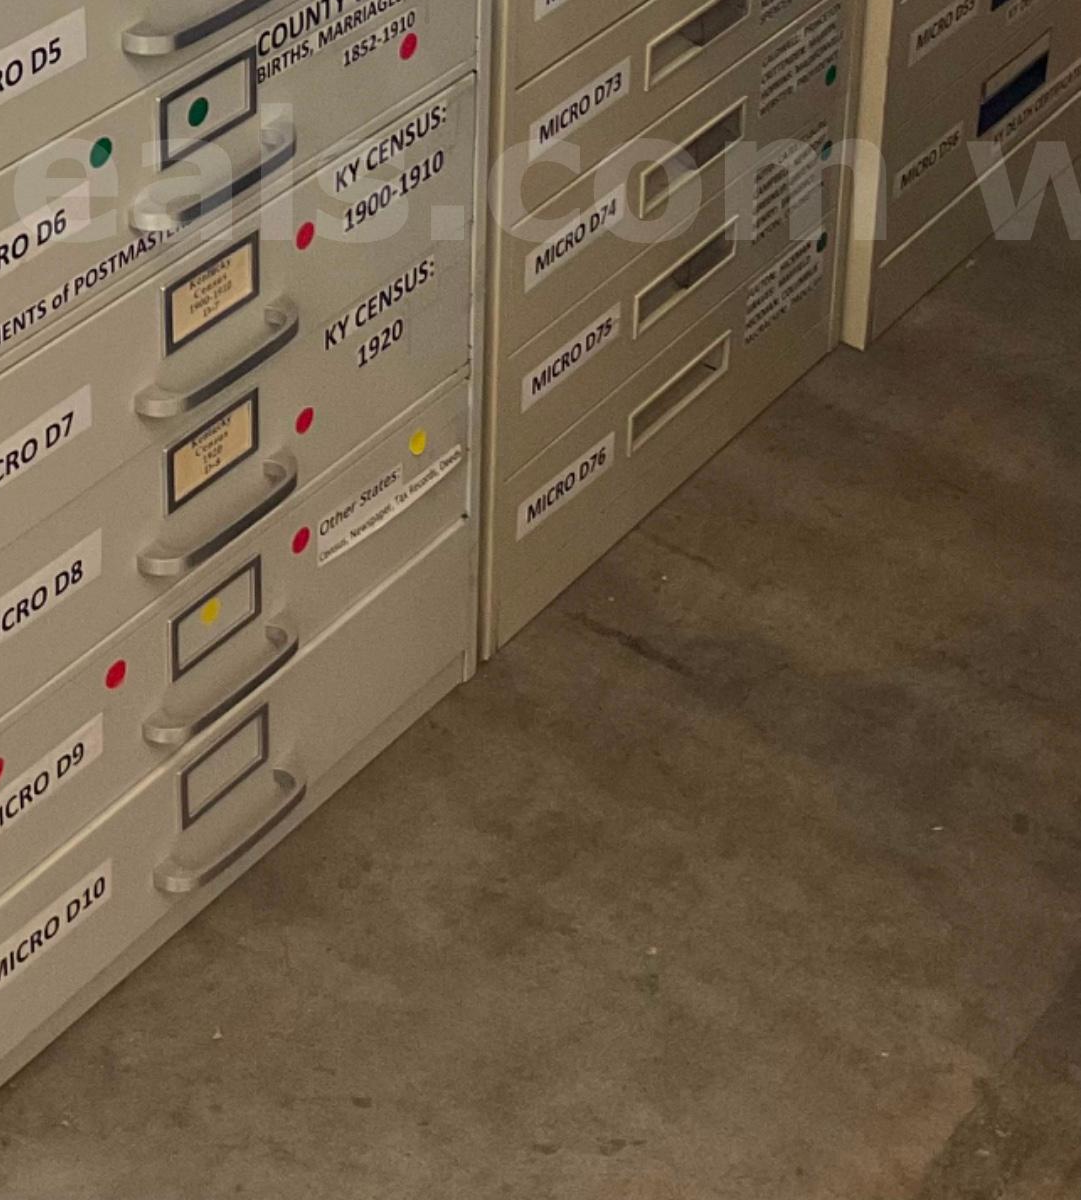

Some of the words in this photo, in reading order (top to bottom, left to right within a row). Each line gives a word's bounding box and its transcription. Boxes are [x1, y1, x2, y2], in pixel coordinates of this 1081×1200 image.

[343, 10, 416, 68] 1852-1910
[916, 12, 953, 50] MICRO
[31, 37, 62, 75] D5
[256, 39, 314, 85] BIRTHS,
[539, 95, 590, 144] MICRO
[594, 71, 622, 105] D73
[336, 157, 360, 192] KY
[366, 105, 447, 171] CENSUS:
[900, 149, 937, 190] MICRO
[344, 150, 444, 232] 1900-1910
[37, 209, 67, 246] D6
[535, 223, 585, 274] MICRO
[589, 198, 616, 232] D74
[52, 286, 70, 309] of
[325, 315, 350, 351] KY
[355, 260, 434, 327] CENSUS:
[358, 319, 403, 368] 1920
[531, 343, 582, 395] MICRO
[585, 317, 612, 353] D75
[45, 411, 74, 449] D7
[526, 472, 575, 523] MICRO
[579, 447, 606, 482] D76
[320, 502, 355, 536] Other
[55, 560, 83, 596] D8
[57, 742, 84, 779] D9
[67, 877, 106, 923] D10
